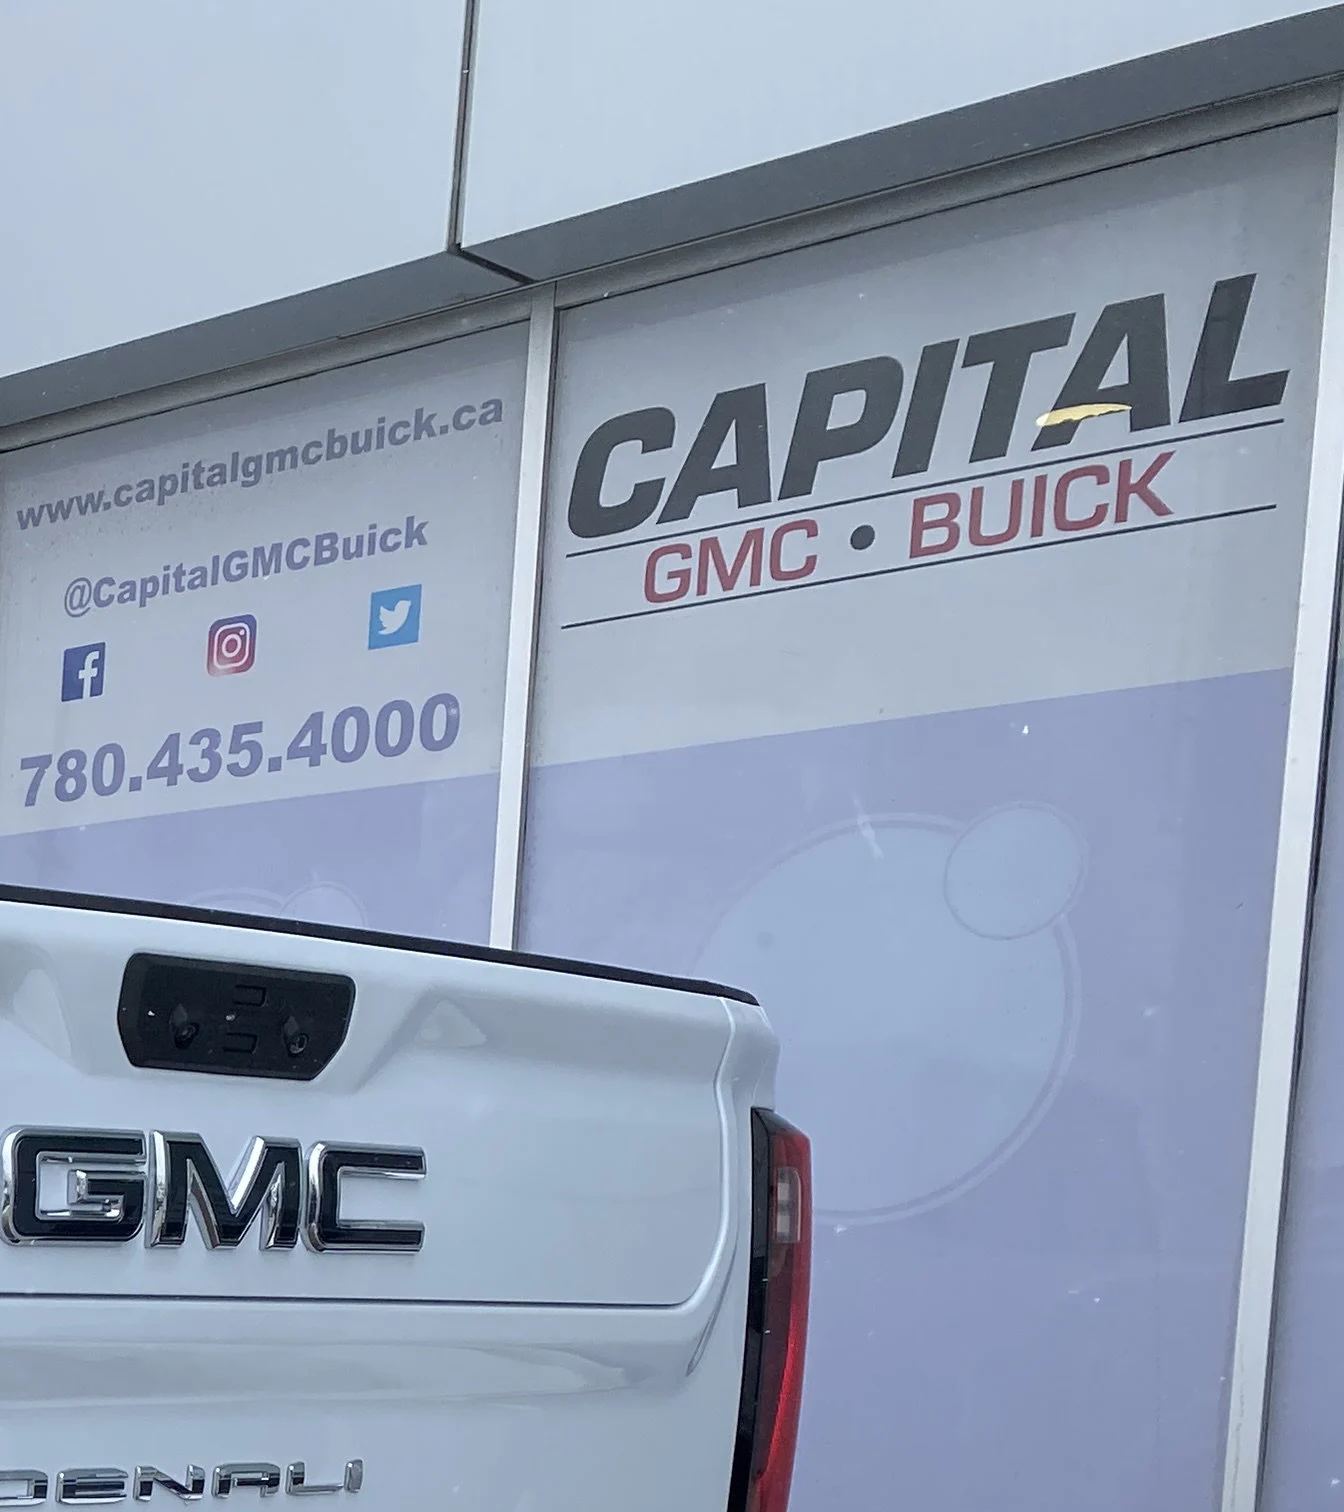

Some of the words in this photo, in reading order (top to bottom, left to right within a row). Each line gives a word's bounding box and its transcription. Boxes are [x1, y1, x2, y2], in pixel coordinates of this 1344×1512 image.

[15, 398, 504, 531] www.capitalgmcbuick.ca
[569, 274, 1289, 540] CAPITAL
[63, 515, 430, 619] @CapitalGMCBuick
[643, 518, 820, 604] GMC
[908, 450, 1176, 560] BUICK
[19, 693, 462, 808] 780.435.4000
